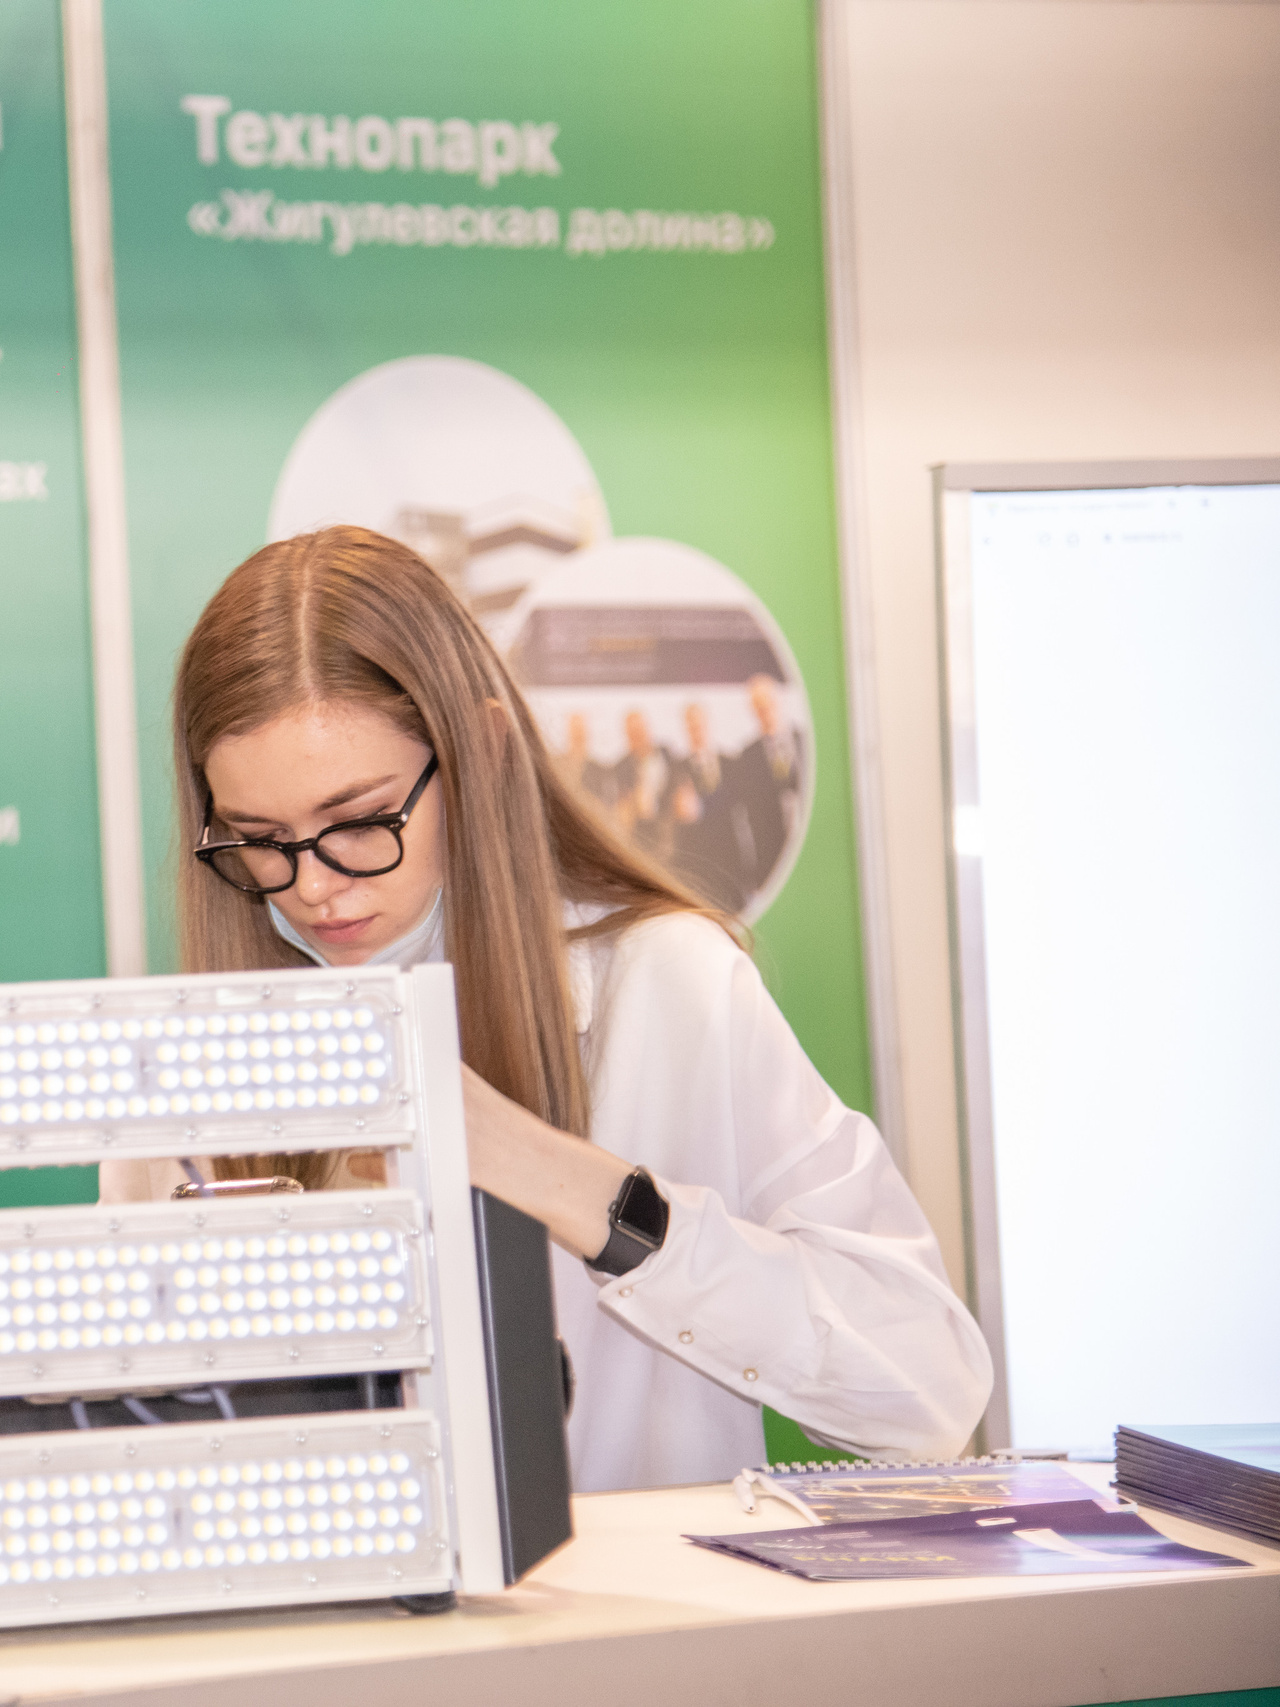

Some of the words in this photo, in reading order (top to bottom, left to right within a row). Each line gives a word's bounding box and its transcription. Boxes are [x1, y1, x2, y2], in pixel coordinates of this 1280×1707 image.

[181, 94, 562, 188] Технопарк
[187, 189, 560, 256] «Жигулевская
[566, 205, 775, 257] долина»
